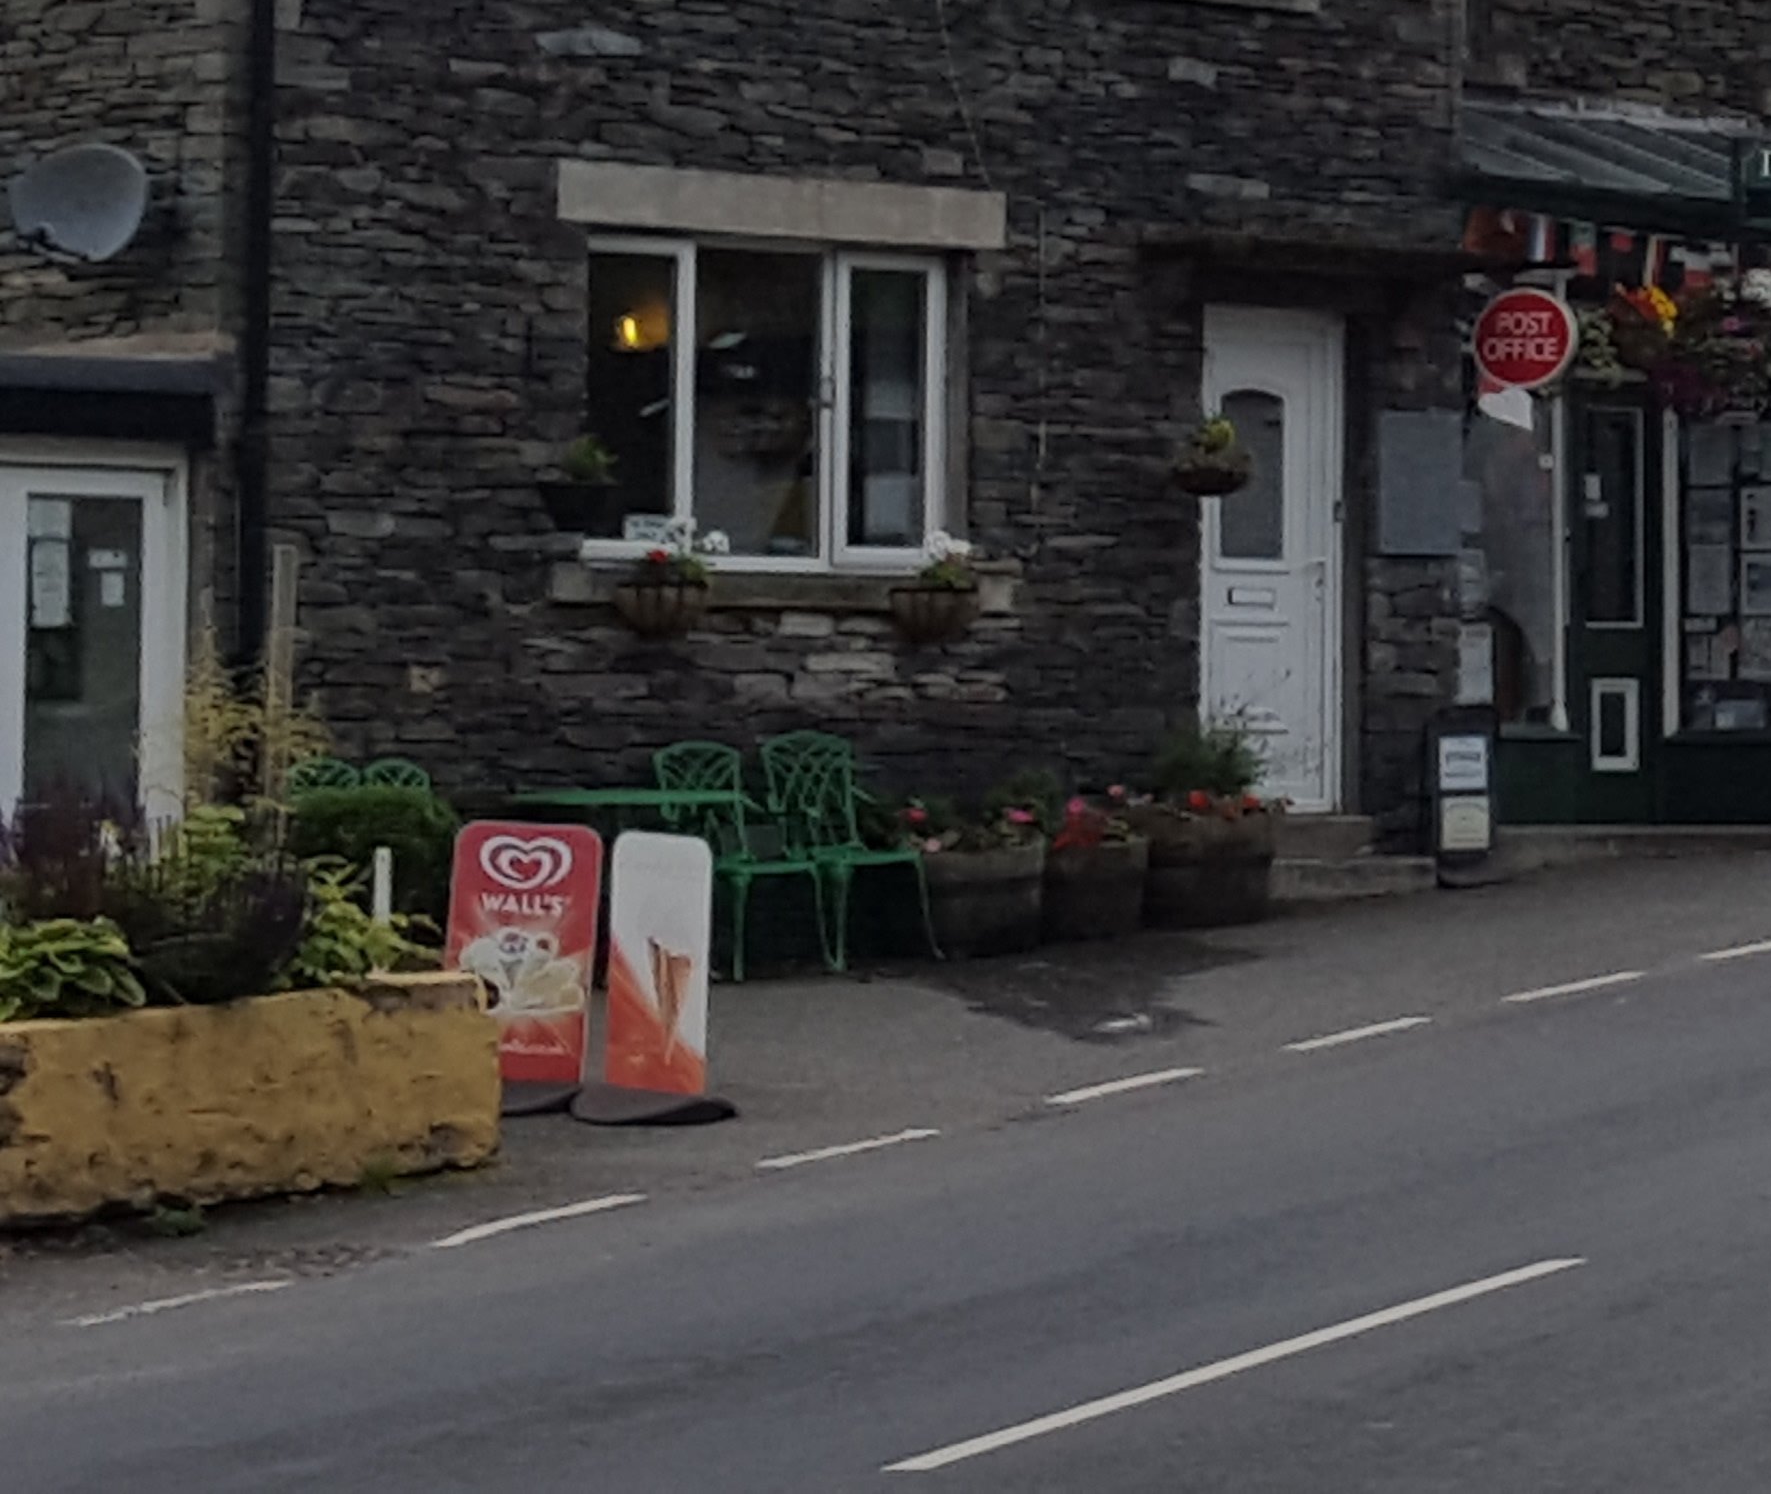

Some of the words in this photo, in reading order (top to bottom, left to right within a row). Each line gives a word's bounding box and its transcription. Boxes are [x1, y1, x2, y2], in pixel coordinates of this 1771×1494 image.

[1497, 311, 1553, 335] POST
[1482, 337, 1559, 361] OFFICE
[481, 892, 564, 917] WALL'S
